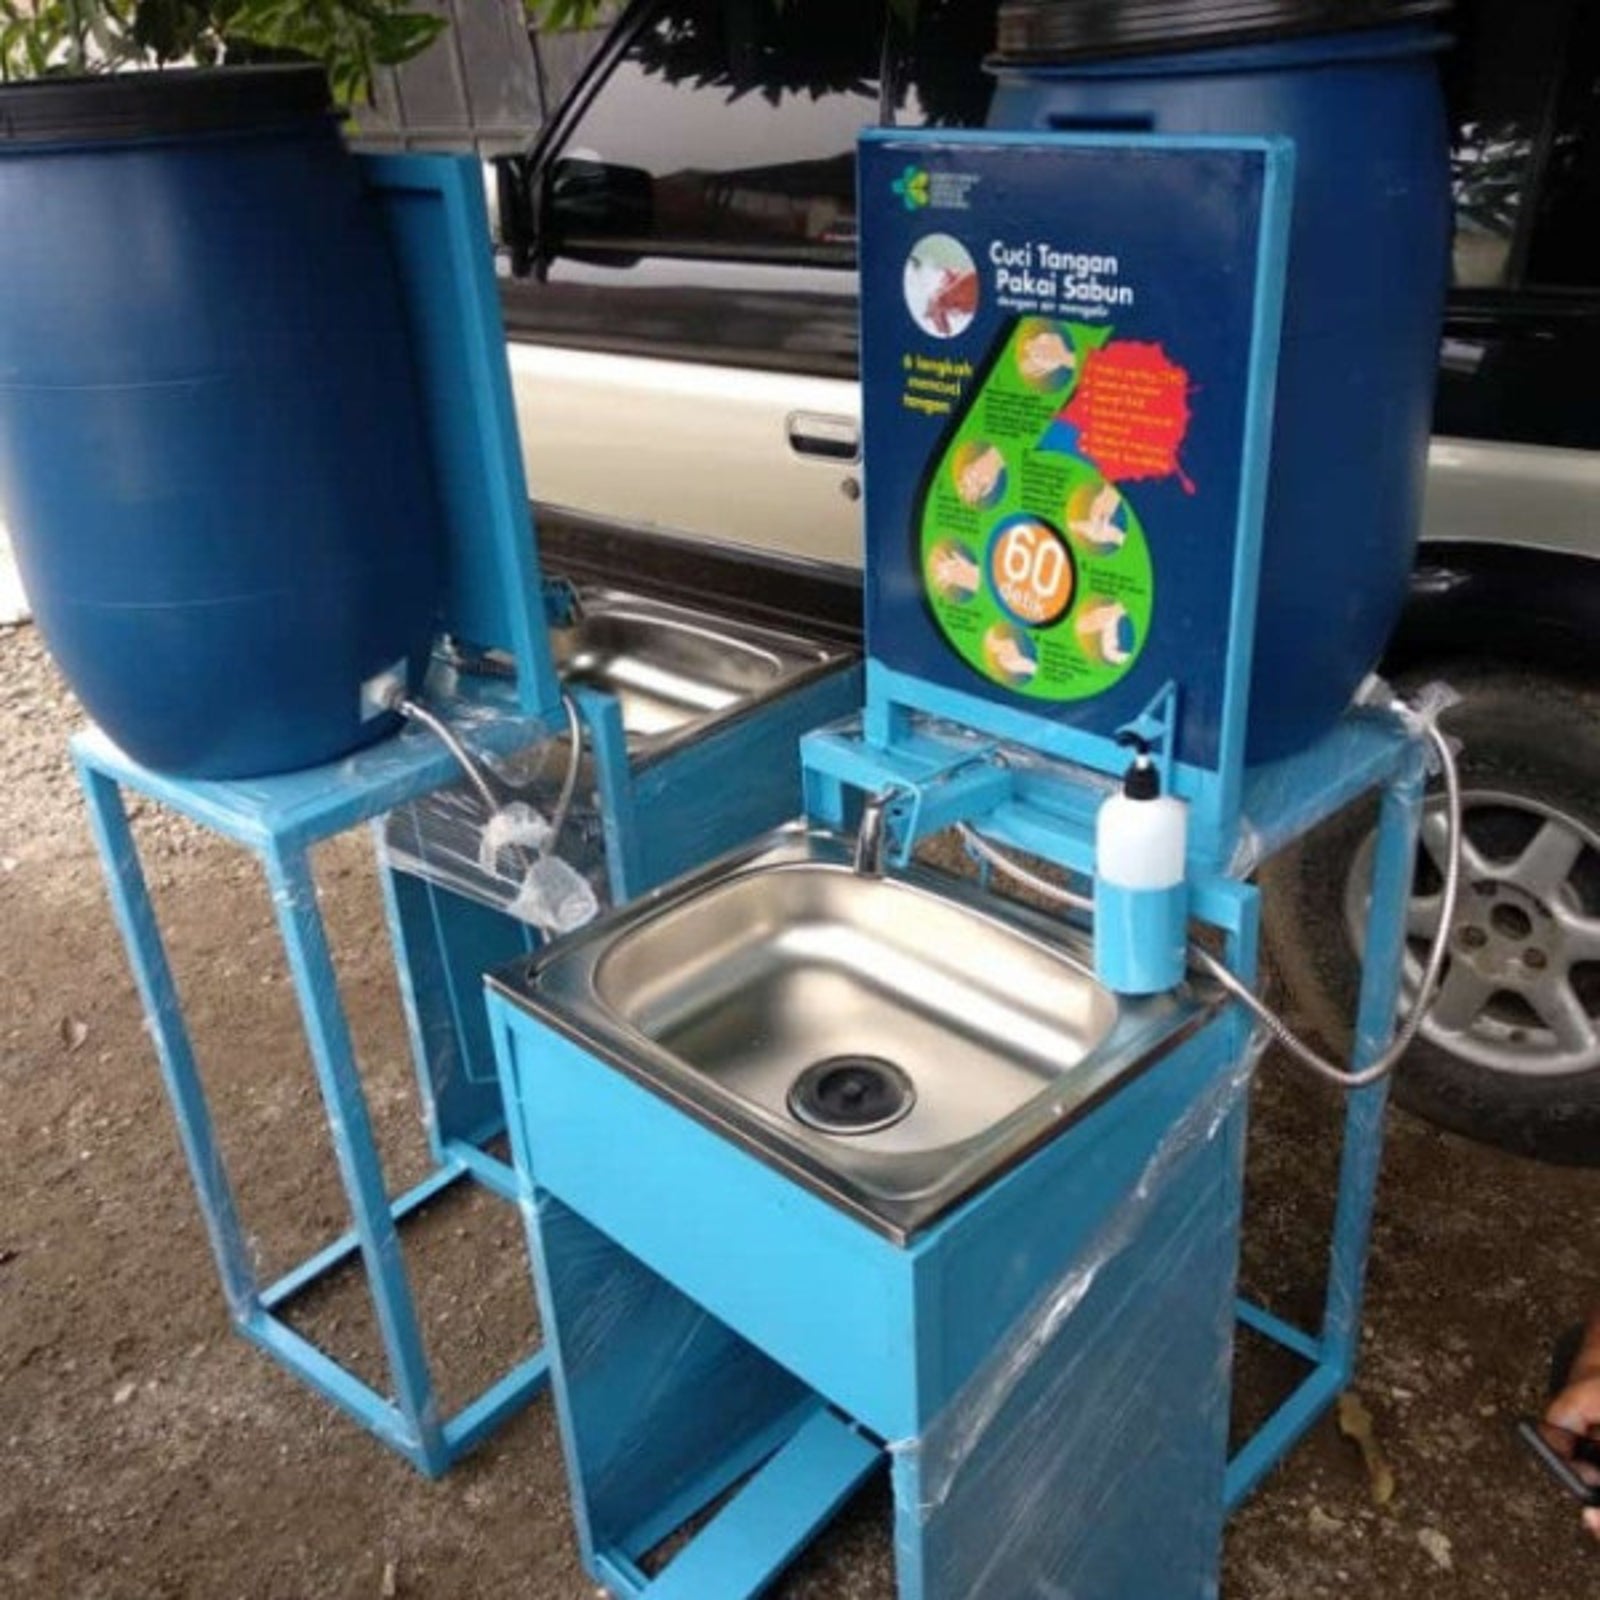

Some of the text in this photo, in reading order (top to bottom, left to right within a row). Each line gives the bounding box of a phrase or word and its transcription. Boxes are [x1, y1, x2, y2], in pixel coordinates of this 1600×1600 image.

[989, 241, 1118, 278] Cuci Tangan
[996, 270, 1134, 305] Pakai Sabun
[1003, 525, 1065, 597] 60
